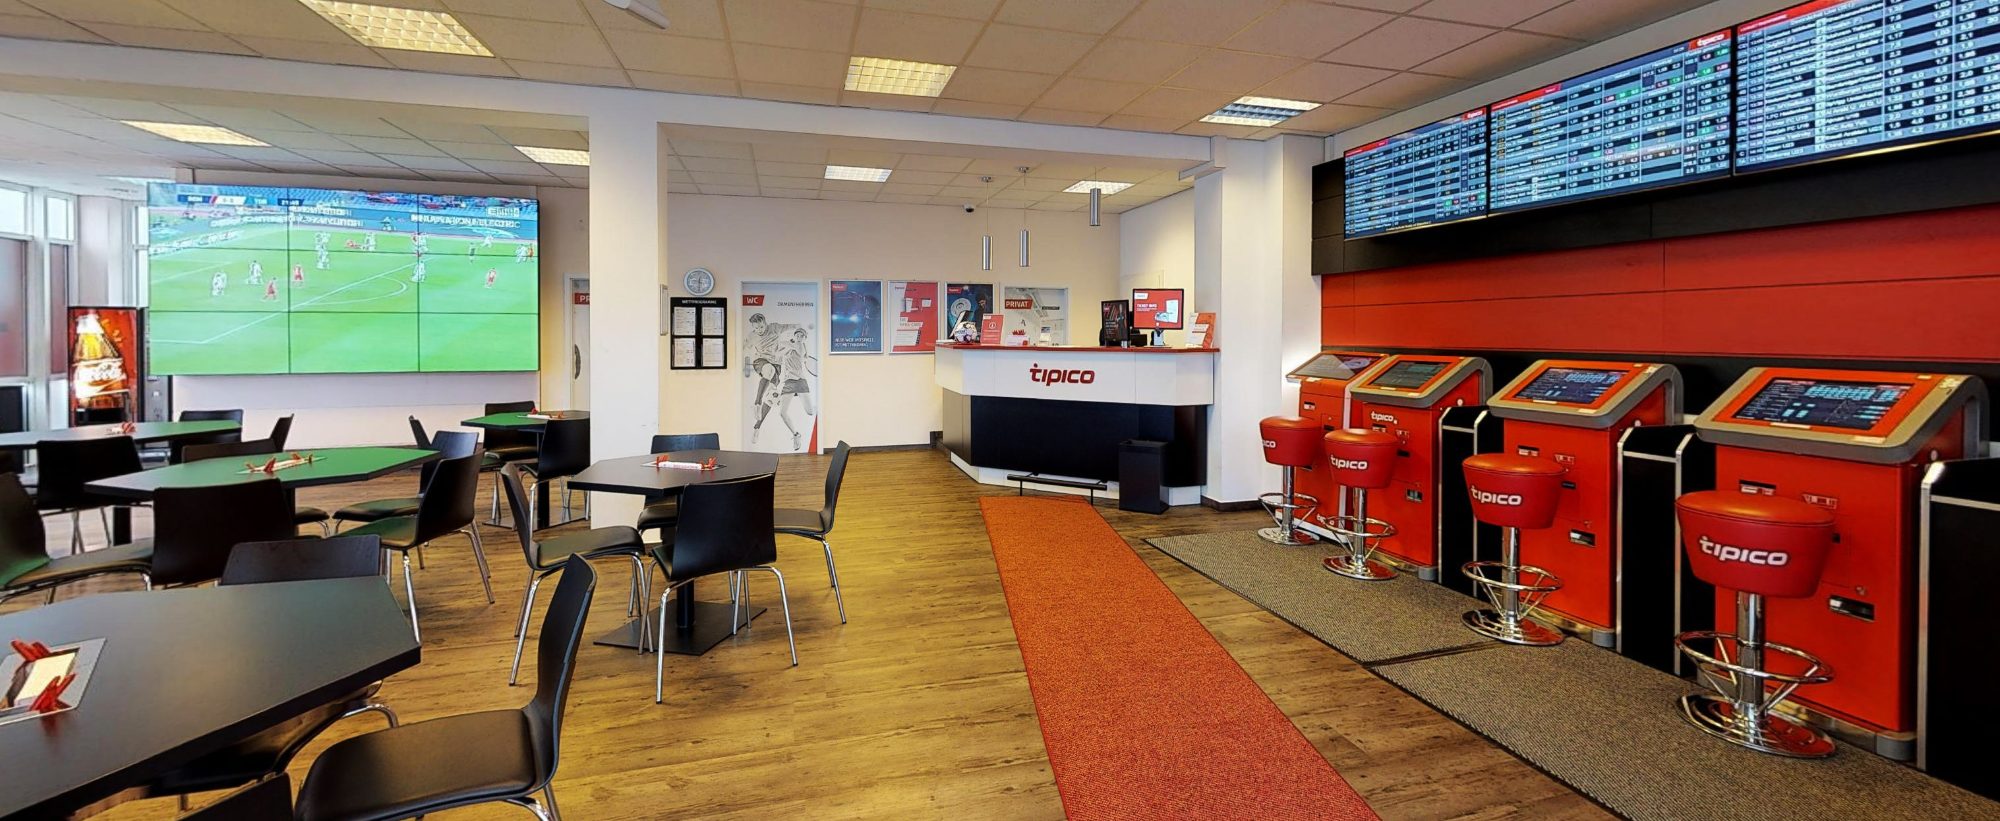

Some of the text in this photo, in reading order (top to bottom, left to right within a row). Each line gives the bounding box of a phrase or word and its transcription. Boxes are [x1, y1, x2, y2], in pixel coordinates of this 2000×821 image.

[1005, 300, 1028, 308] PRIVAT
[1030, 363, 1095, 387] tipico
[1371, 411, 1394, 422] tipico
[1331, 454, 1368, 470] tipico
[1470, 484, 1522, 505] tipico
[1699, 535, 1788, 566] tipico
